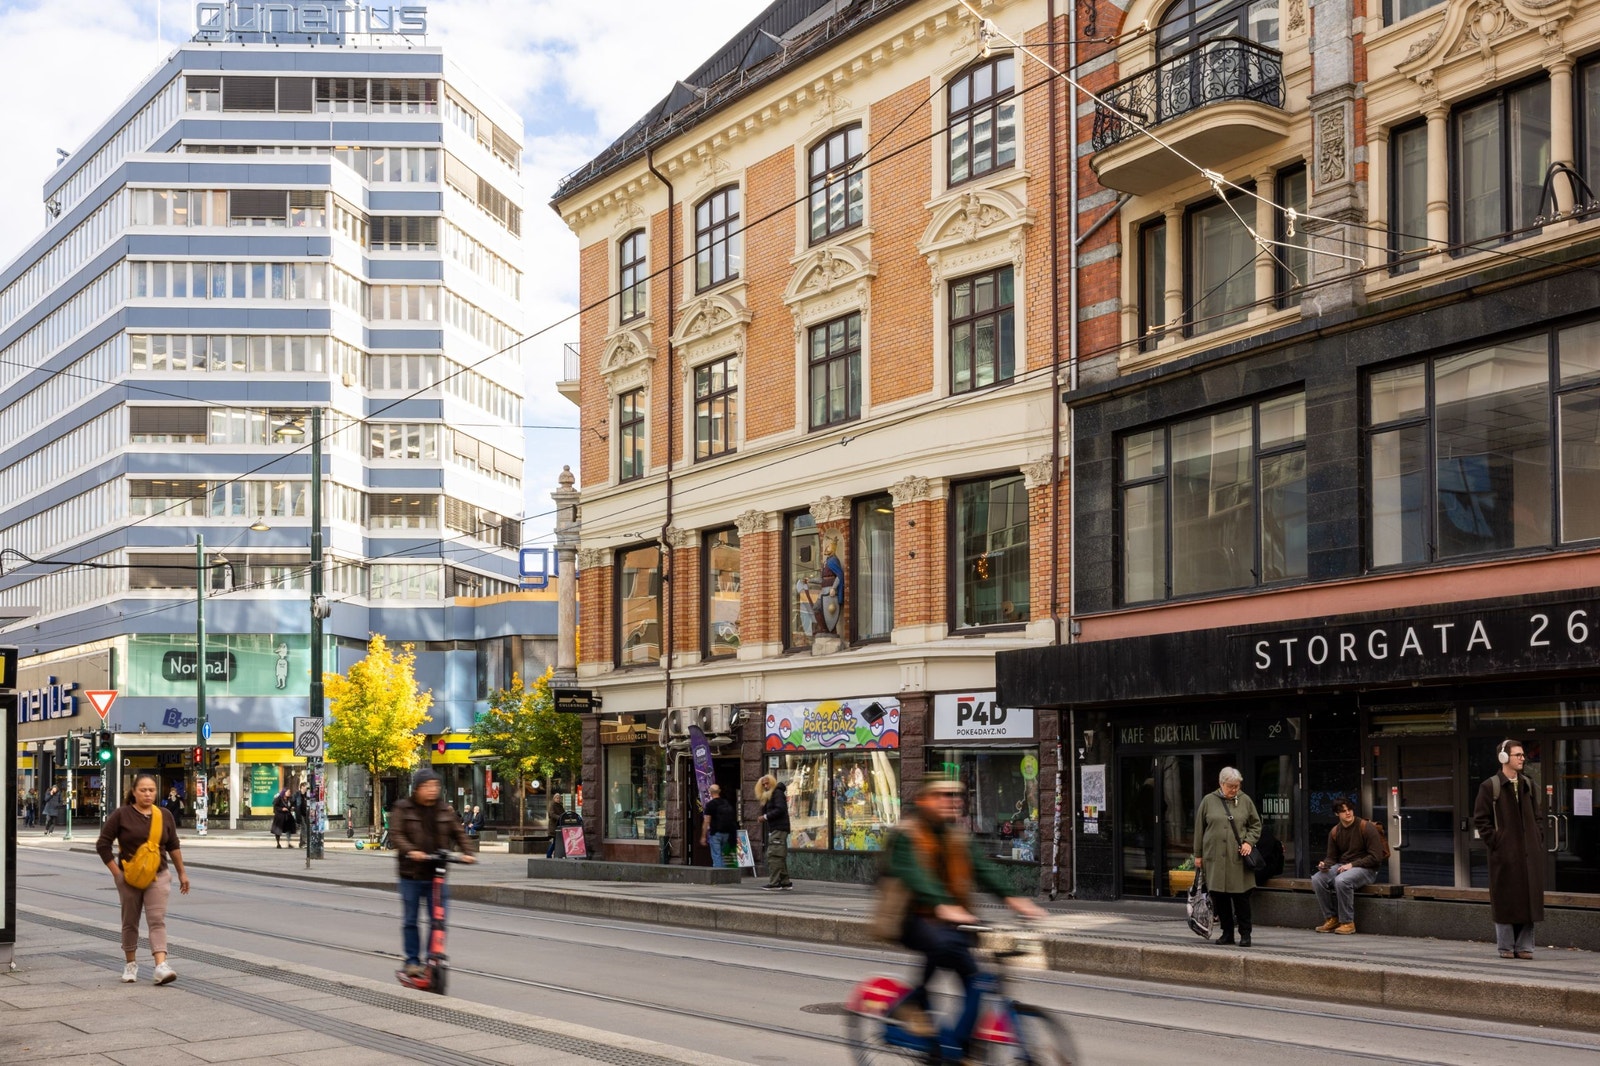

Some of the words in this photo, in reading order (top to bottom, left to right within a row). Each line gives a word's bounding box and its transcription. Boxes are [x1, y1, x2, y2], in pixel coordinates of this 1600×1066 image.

[196, 0, 428, 42] gunerius
[1255, 620, 1492, 670] STORGATA
[1529, 609, 1589, 647] 26
[170, 656, 227, 675] Normal
[17, 675, 78, 724] nerius
[957, 701, 1008, 726] P4D
[803, 717, 858, 735] POKE4DAYZ
[956, 728, 1007, 736] POKE4DAYZ.NO
[1154, 724, 1200, 743] COCKTAIL
[1210, 722, 1240, 740] VINYL
